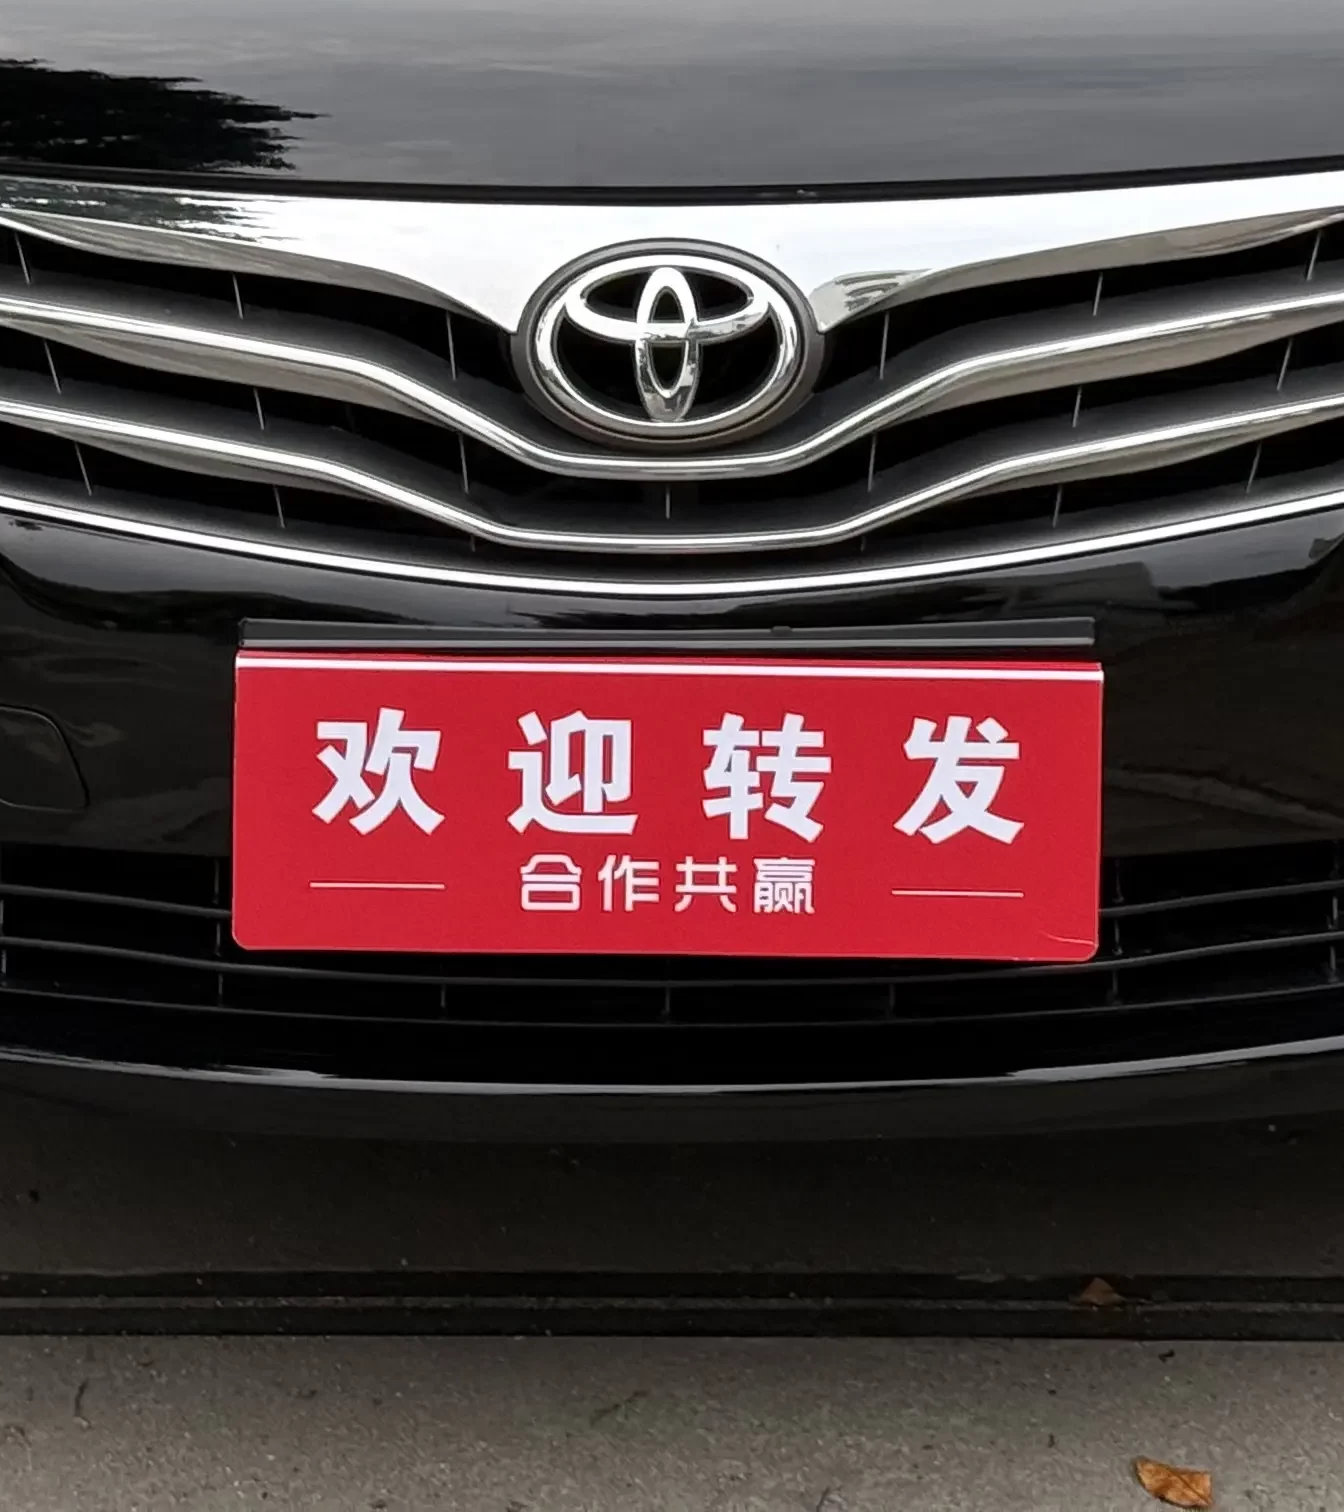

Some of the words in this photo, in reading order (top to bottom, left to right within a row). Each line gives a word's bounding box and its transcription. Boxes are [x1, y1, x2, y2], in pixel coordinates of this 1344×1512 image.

[312, 706, 1025, 845] 欢迎转发
[520, 854, 816, 914] 合作共赢
